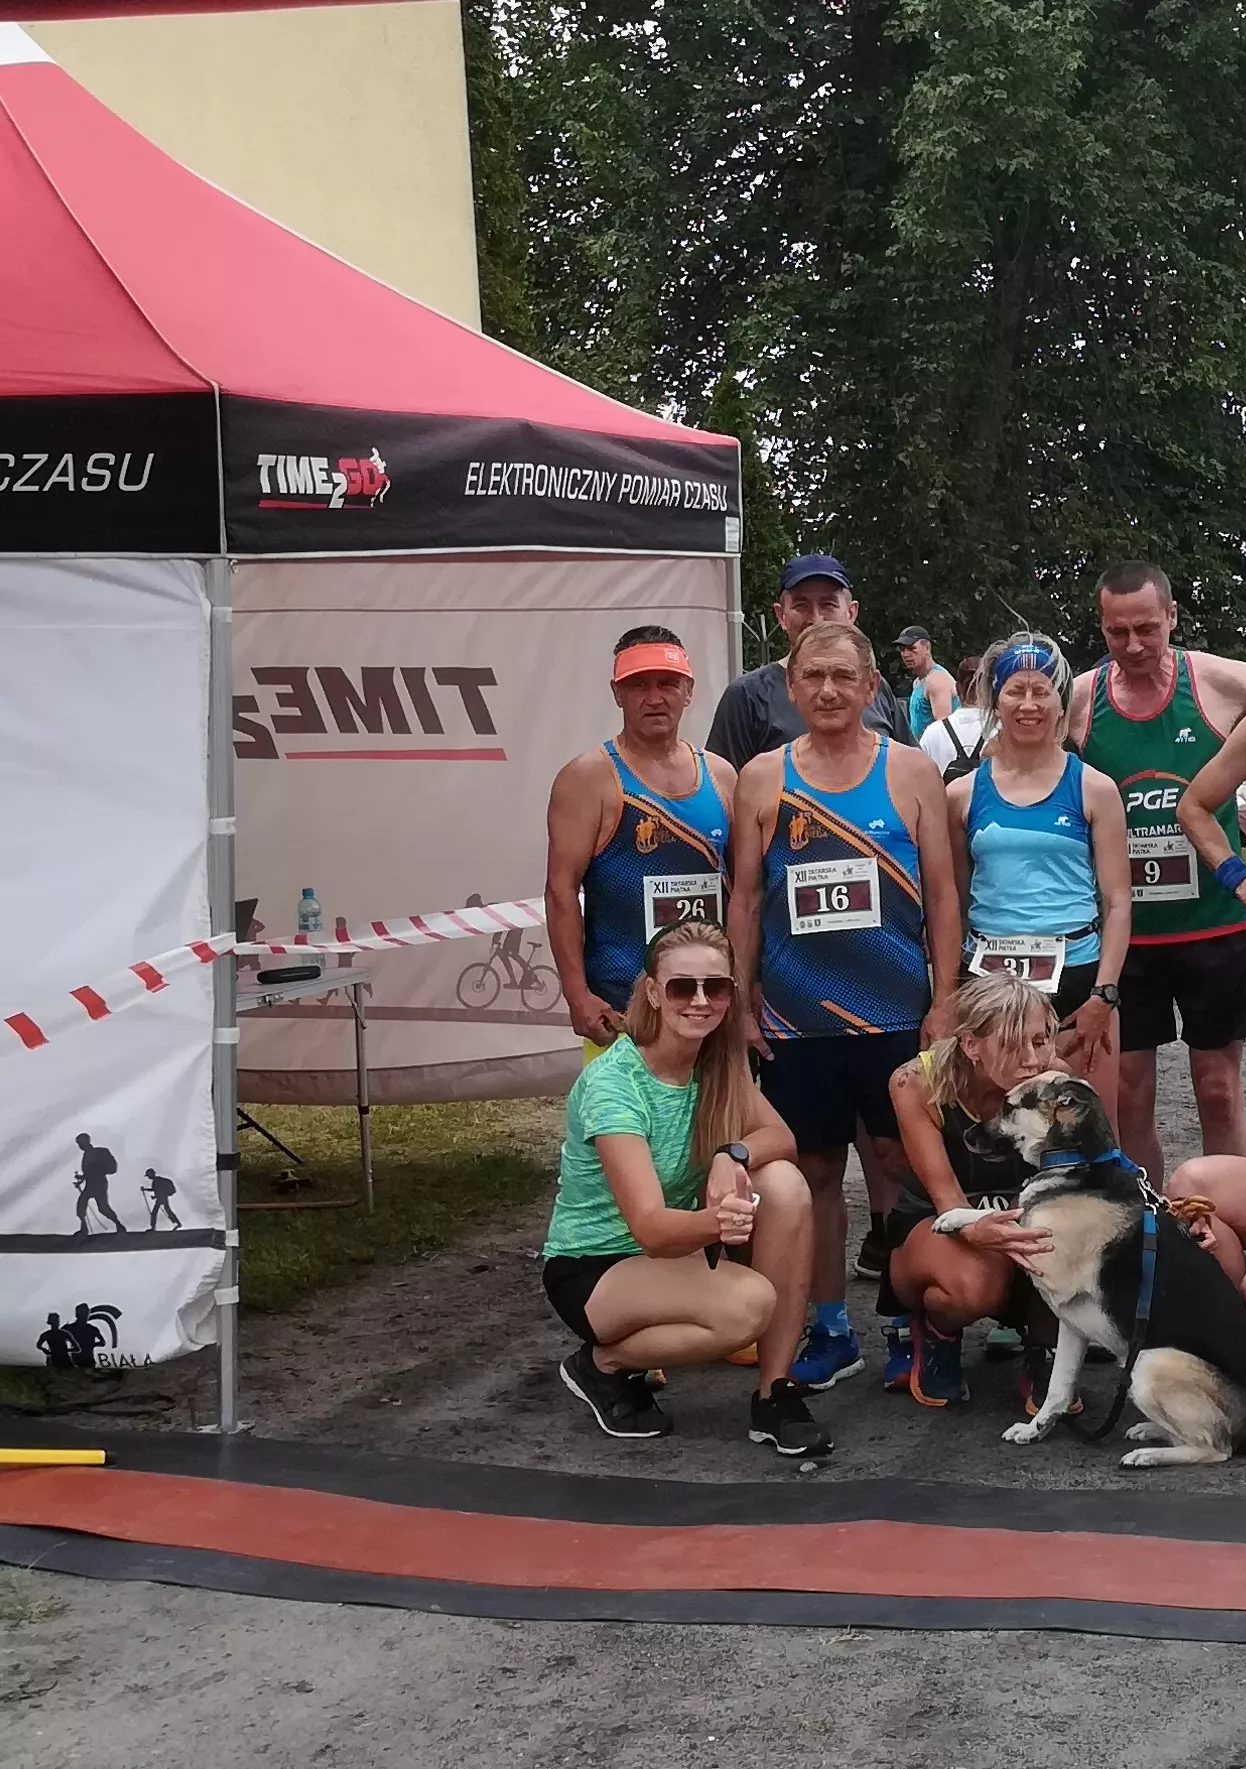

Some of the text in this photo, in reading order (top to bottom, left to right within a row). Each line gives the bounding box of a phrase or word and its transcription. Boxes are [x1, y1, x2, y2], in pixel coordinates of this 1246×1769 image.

[464, 462, 728, 512] ELEKTRONICZNY POMIAR CZASU
[1126, 788, 1180, 812] PGE
[795, 869, 808, 883] XII
[1144, 861, 1161, 884] 9
[653, 881, 669, 894] XII
[815, 885, 850, 912] 16
[676, 899, 706, 920] 26
[985, 940, 997, 951] XII
[1003, 957, 1031, 980] 31
